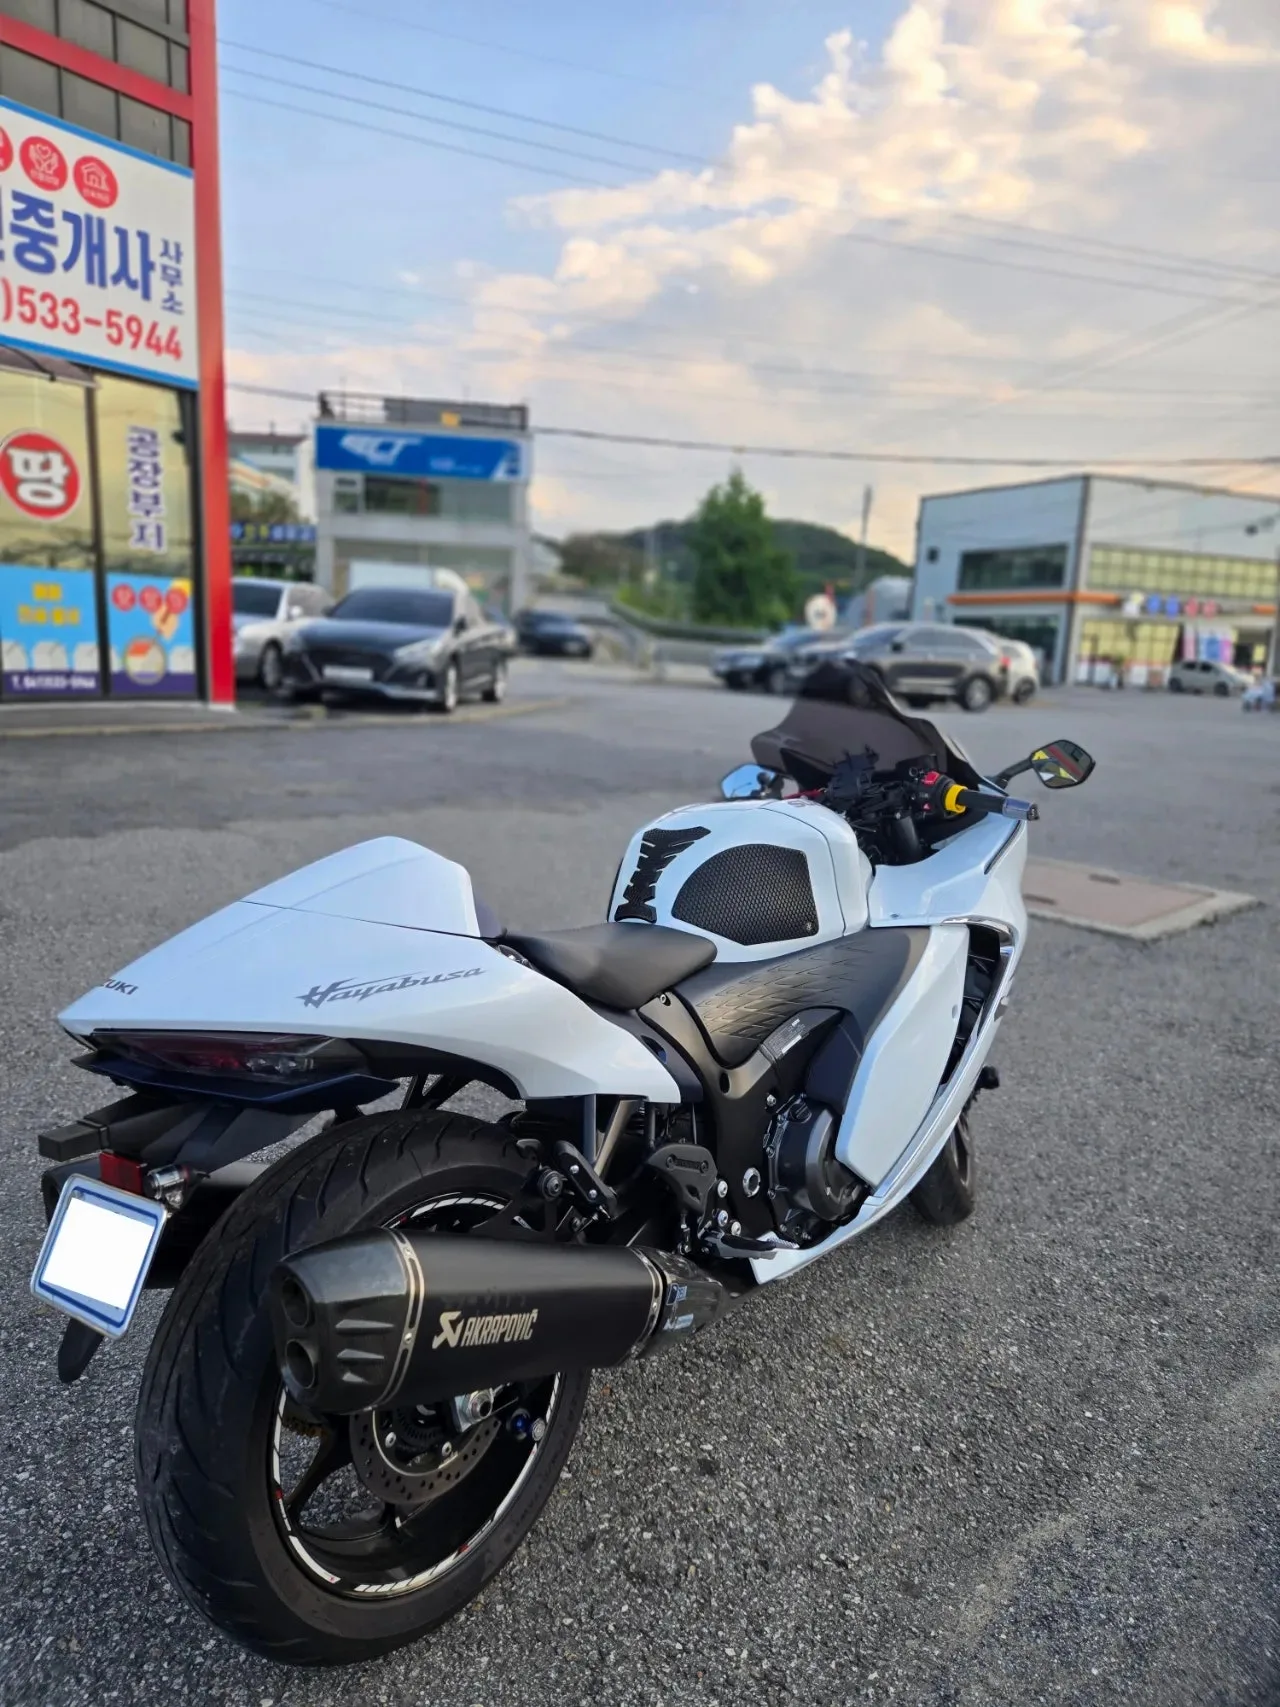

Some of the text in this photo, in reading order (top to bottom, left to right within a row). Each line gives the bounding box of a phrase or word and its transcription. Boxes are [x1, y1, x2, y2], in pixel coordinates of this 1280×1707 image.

[0, 184, 155, 302] 중개사
[160, 238, 184, 315] 사무소
[8, 446, 69, 509] 땅
[127, 425, 164, 552] 공장부지
[296, 967, 486, 1008] Hayabusa
